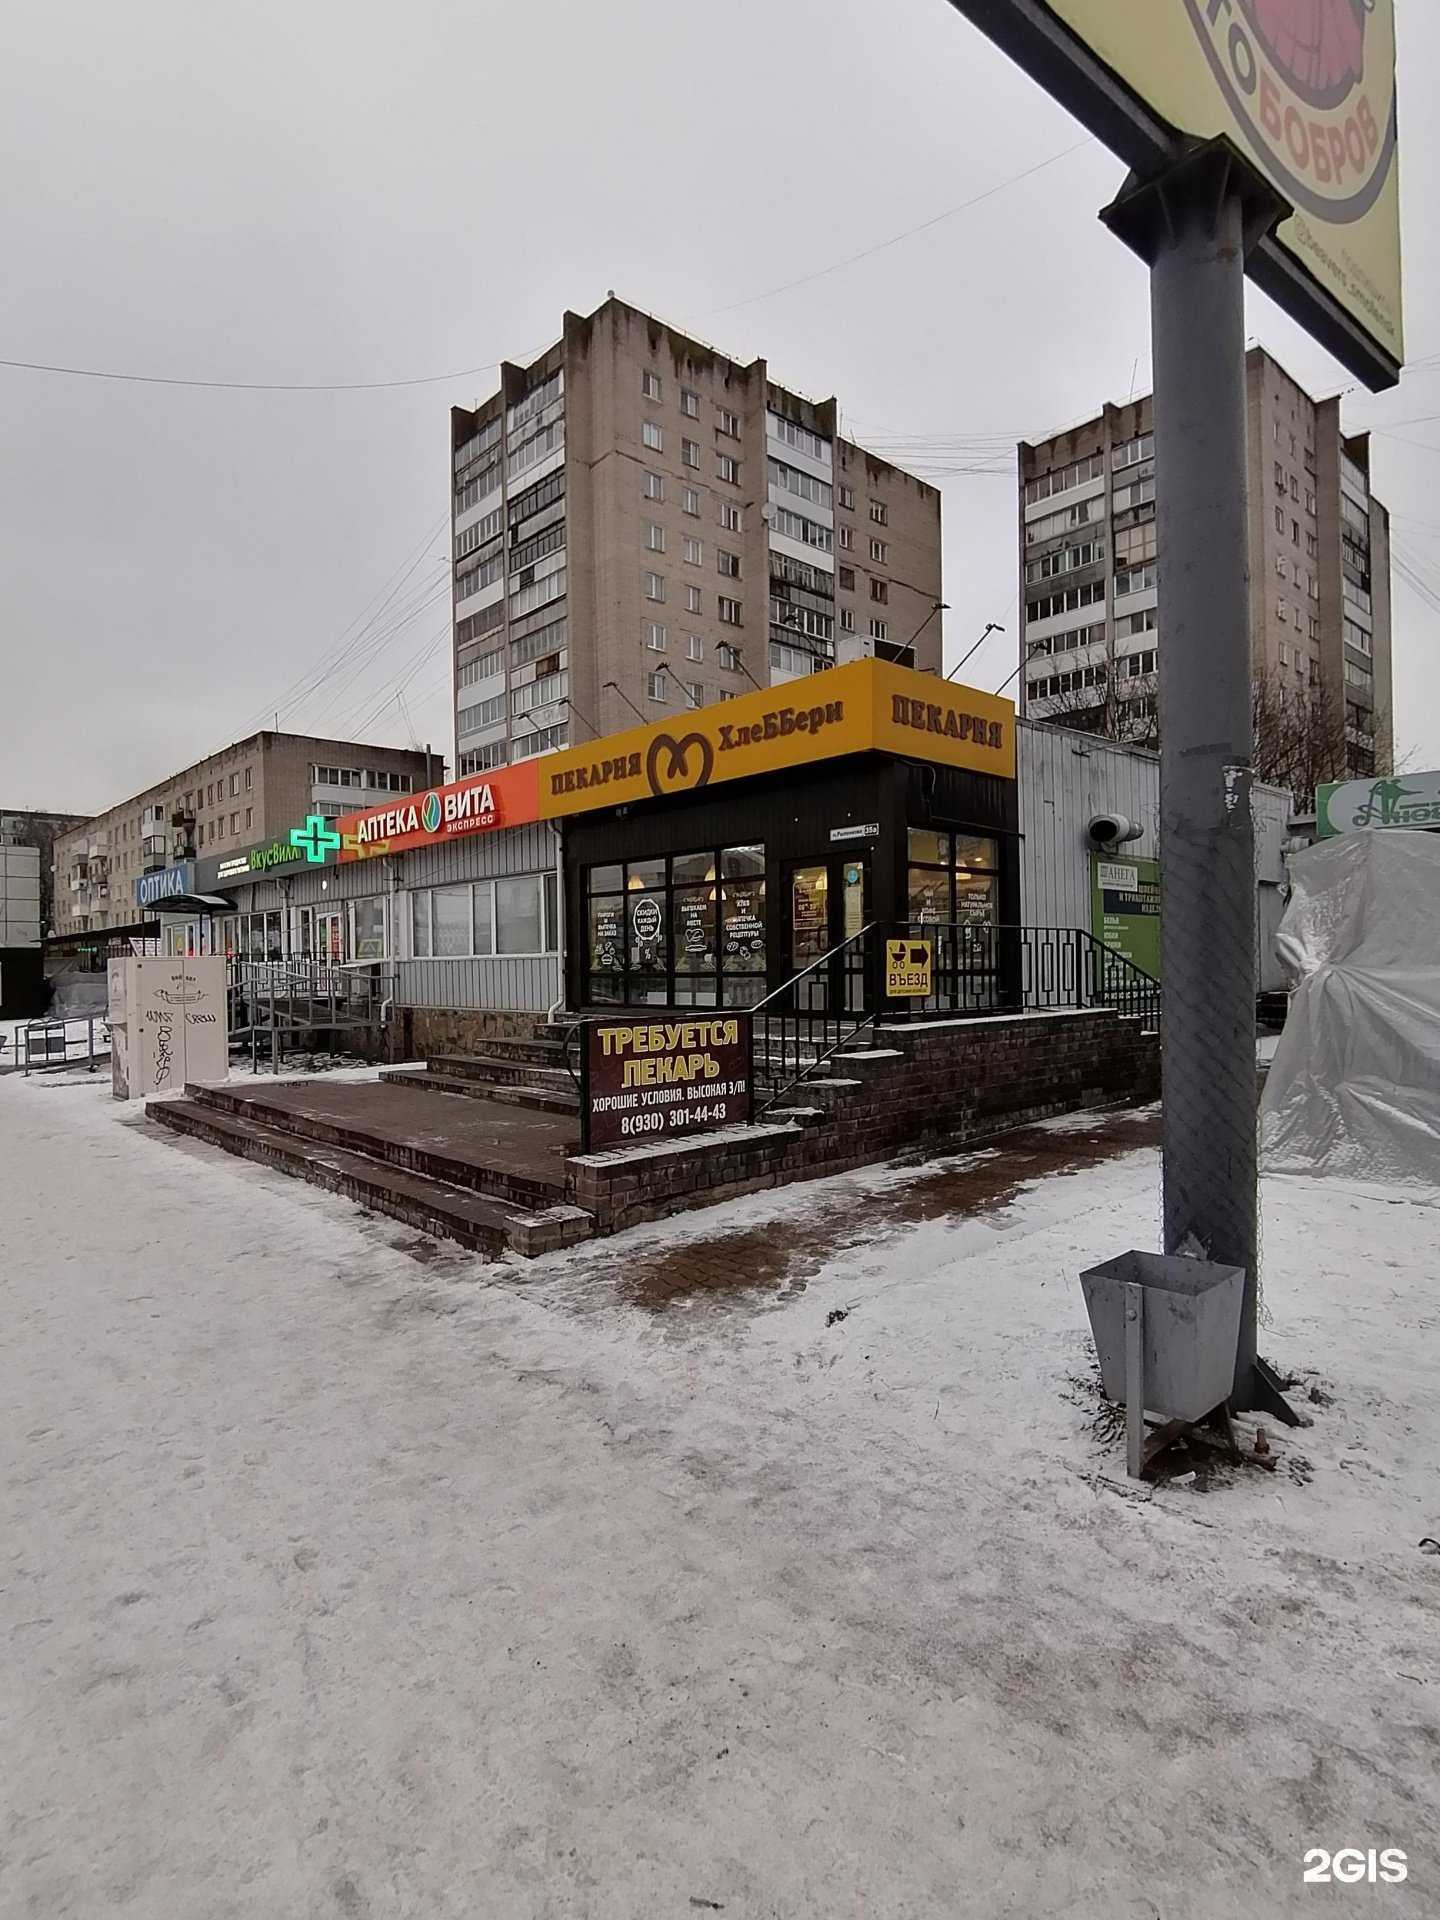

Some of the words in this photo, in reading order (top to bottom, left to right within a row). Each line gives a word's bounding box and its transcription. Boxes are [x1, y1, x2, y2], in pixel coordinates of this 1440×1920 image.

[1260, 66, 1379, 186] БОБРОВ
[892, 694, 1004, 749] ПЕКАРНЯ
[551, 752, 642, 796] ПЕКАРНЯ
[718, 700, 844, 752] ХлеББери
[358, 804, 419, 844] АПТЕКА
[444, 783, 495, 822] ВИТА
[446, 814, 494, 833] ЭКСПРЕСС
[250, 842, 299, 872] ВкусВилл
[140, 870, 184, 903] ОПТИКА
[636, 908, 657, 917] СКИДКИ
[640, 925, 654, 933] ДЕНЬ
[889, 972, 929, 988] ВЪЕЗД
[597, 1019, 739, 1056] ТРЕБУЕТСЯ
[621, 1052, 720, 1089] ПЕКАРЬ
[592, 1092, 638, 1113] ХОРОШИЕ
[641, 1087, 685, 1106] УСЛОВИЯ.
[687, 1082, 727, 1100] ВЫСОКАЯ
[621, 1112, 664, 1135] 8(930)
[669, 1103, 727, 1128] 301-44-43
